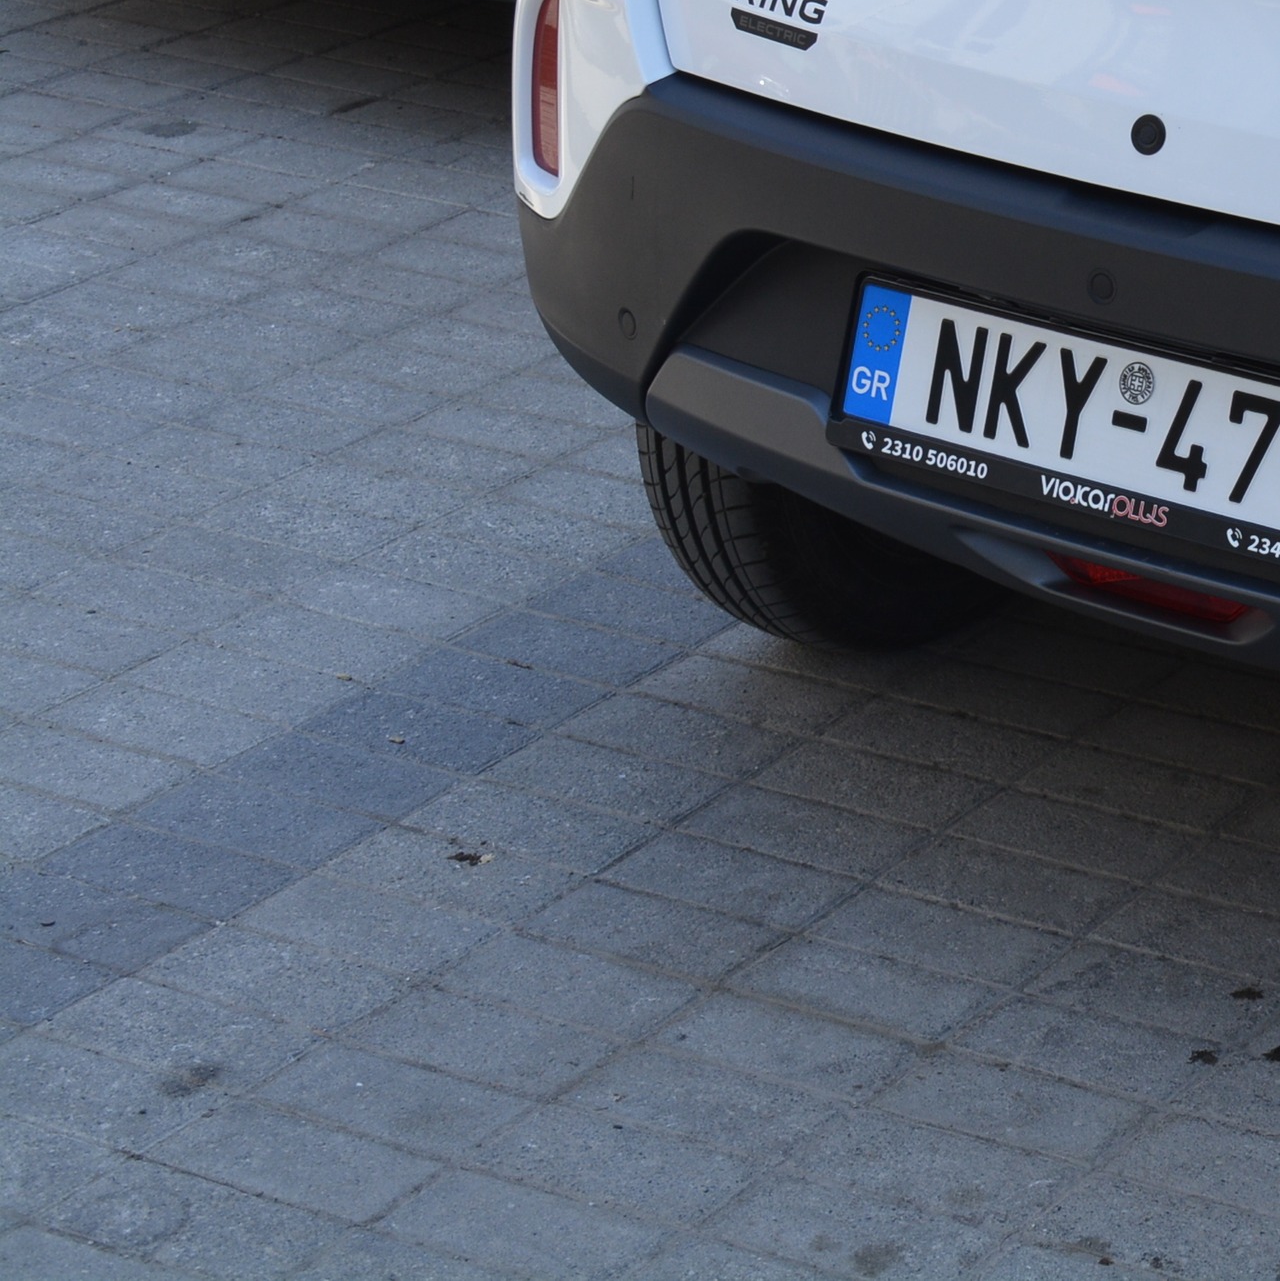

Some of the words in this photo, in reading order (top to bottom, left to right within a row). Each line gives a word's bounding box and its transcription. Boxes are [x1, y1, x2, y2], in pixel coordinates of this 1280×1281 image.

[739, 15, 807, 46] ELECTRIC
[852, 366, 891, 401] GR
[881, 437, 924, 462] 2310
[925, 449, 988, 479] 506010
